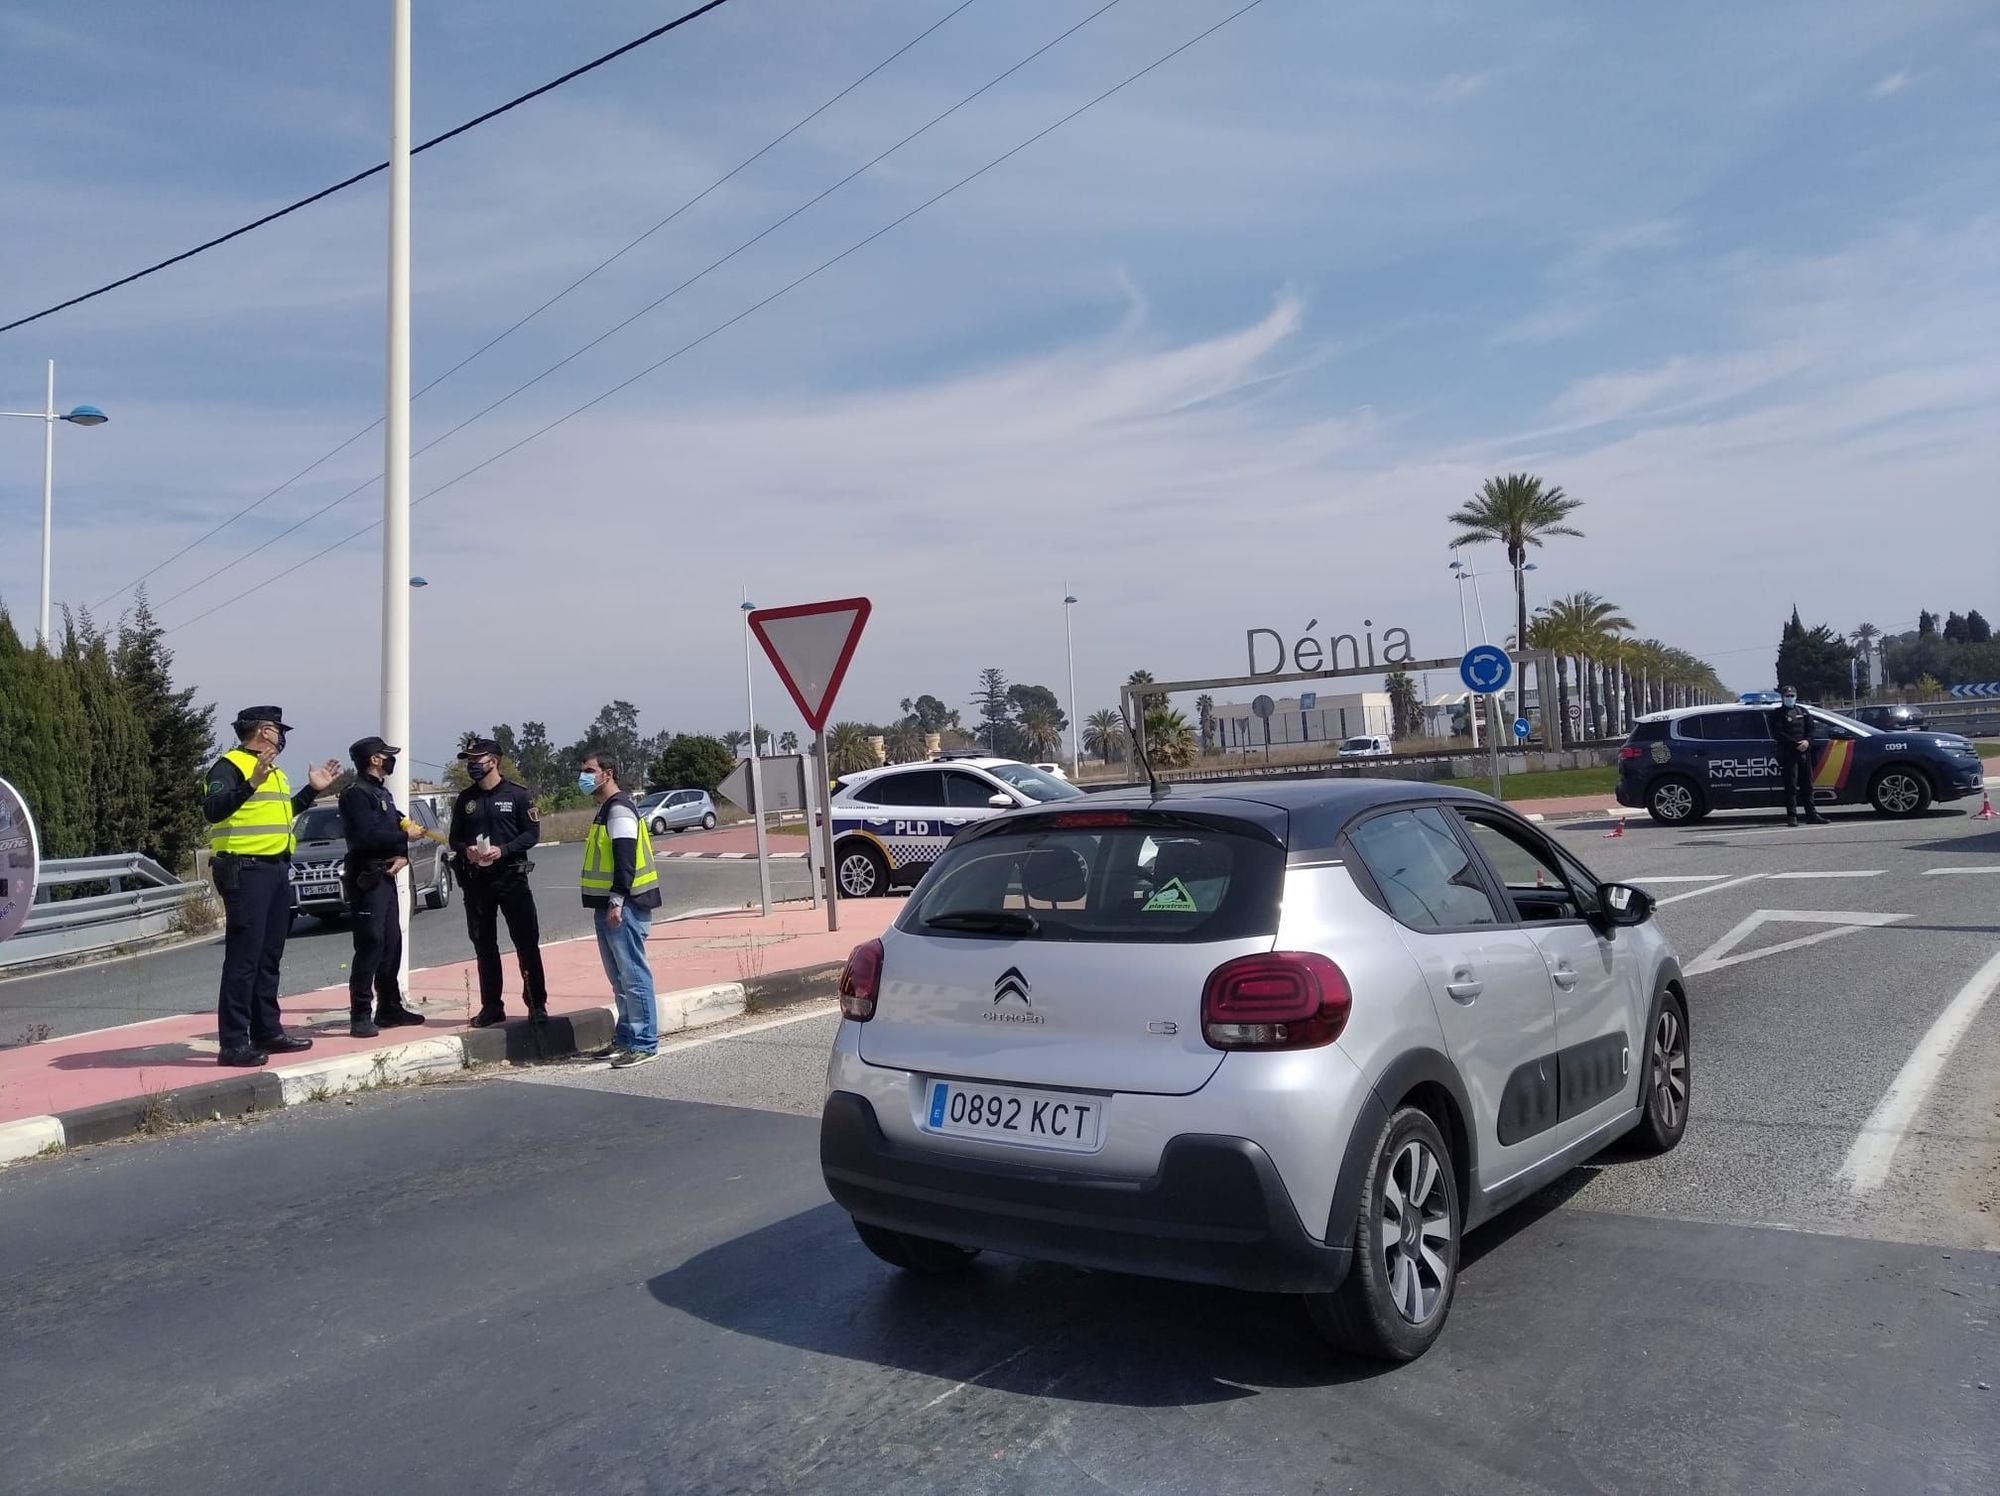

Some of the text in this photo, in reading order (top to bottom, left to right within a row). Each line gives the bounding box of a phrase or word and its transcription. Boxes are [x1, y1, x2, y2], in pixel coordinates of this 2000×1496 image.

[1247, 619, 1415, 676] Dénia
[895, 820, 929, 836] PLD
[1147, 1021, 1178, 1035] C3
[950, 1092, 1022, 1131] 0892
[1030, 1100, 1091, 1139] KCT
